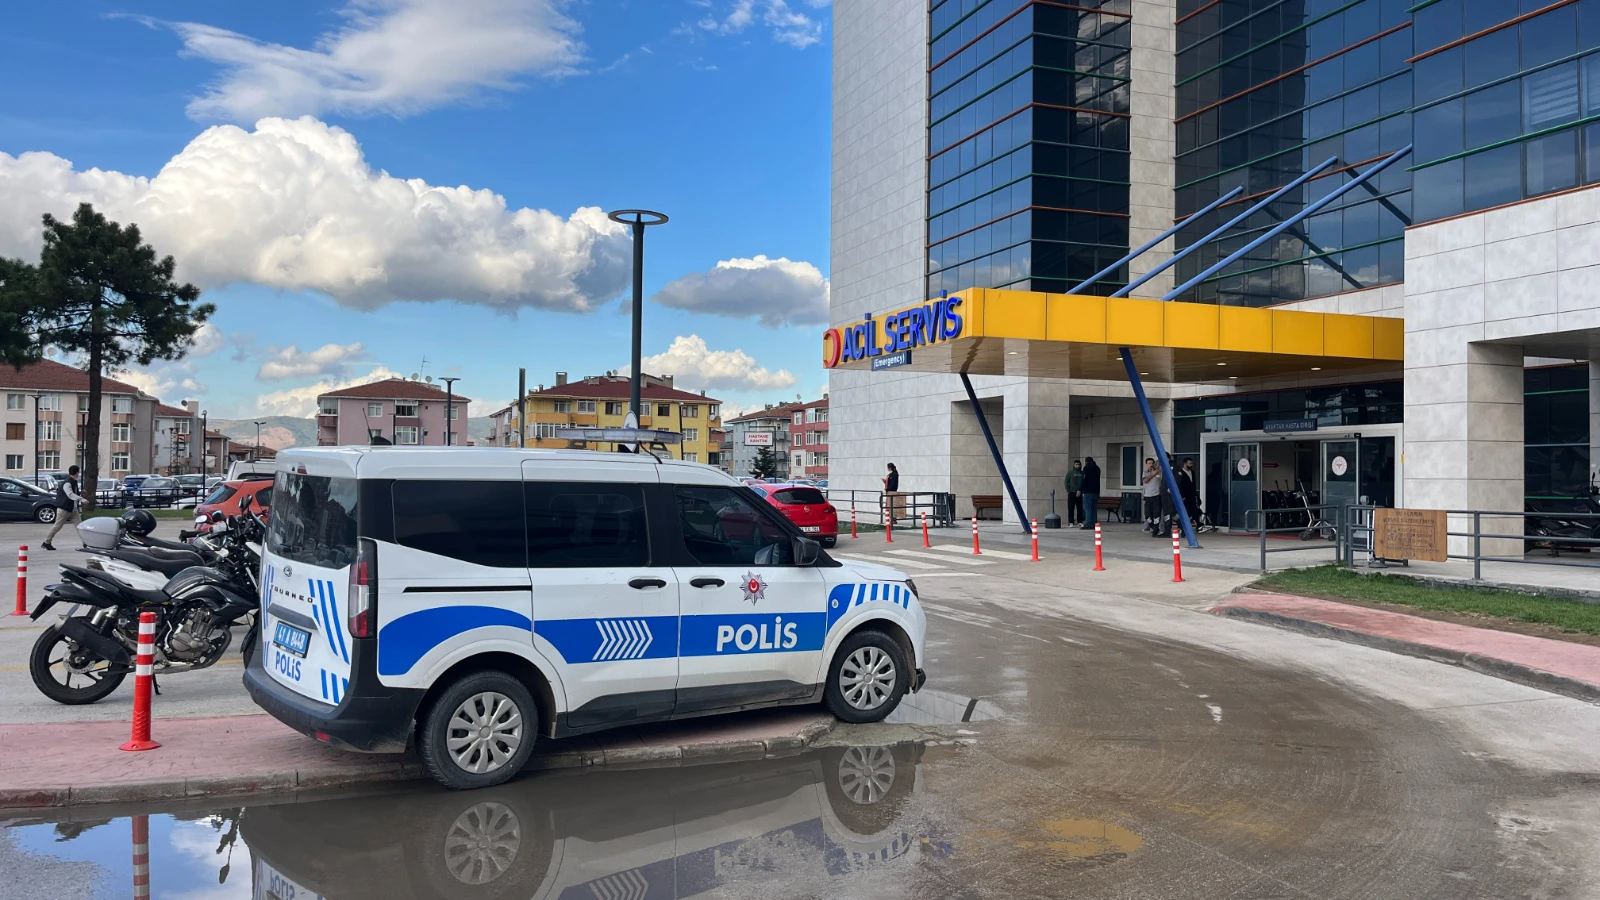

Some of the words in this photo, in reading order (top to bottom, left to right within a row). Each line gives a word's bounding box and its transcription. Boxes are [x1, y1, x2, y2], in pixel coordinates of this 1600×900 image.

[841, 313, 882, 362] ACİL
[883, 289, 963, 353] SERVİS
[270, 585, 313, 603] TOURNEO
[278, 625, 286, 642] 41
[285, 629, 291, 645] A
[716, 616, 798, 652] POLİS
[275, 651, 301, 682] POLİS
